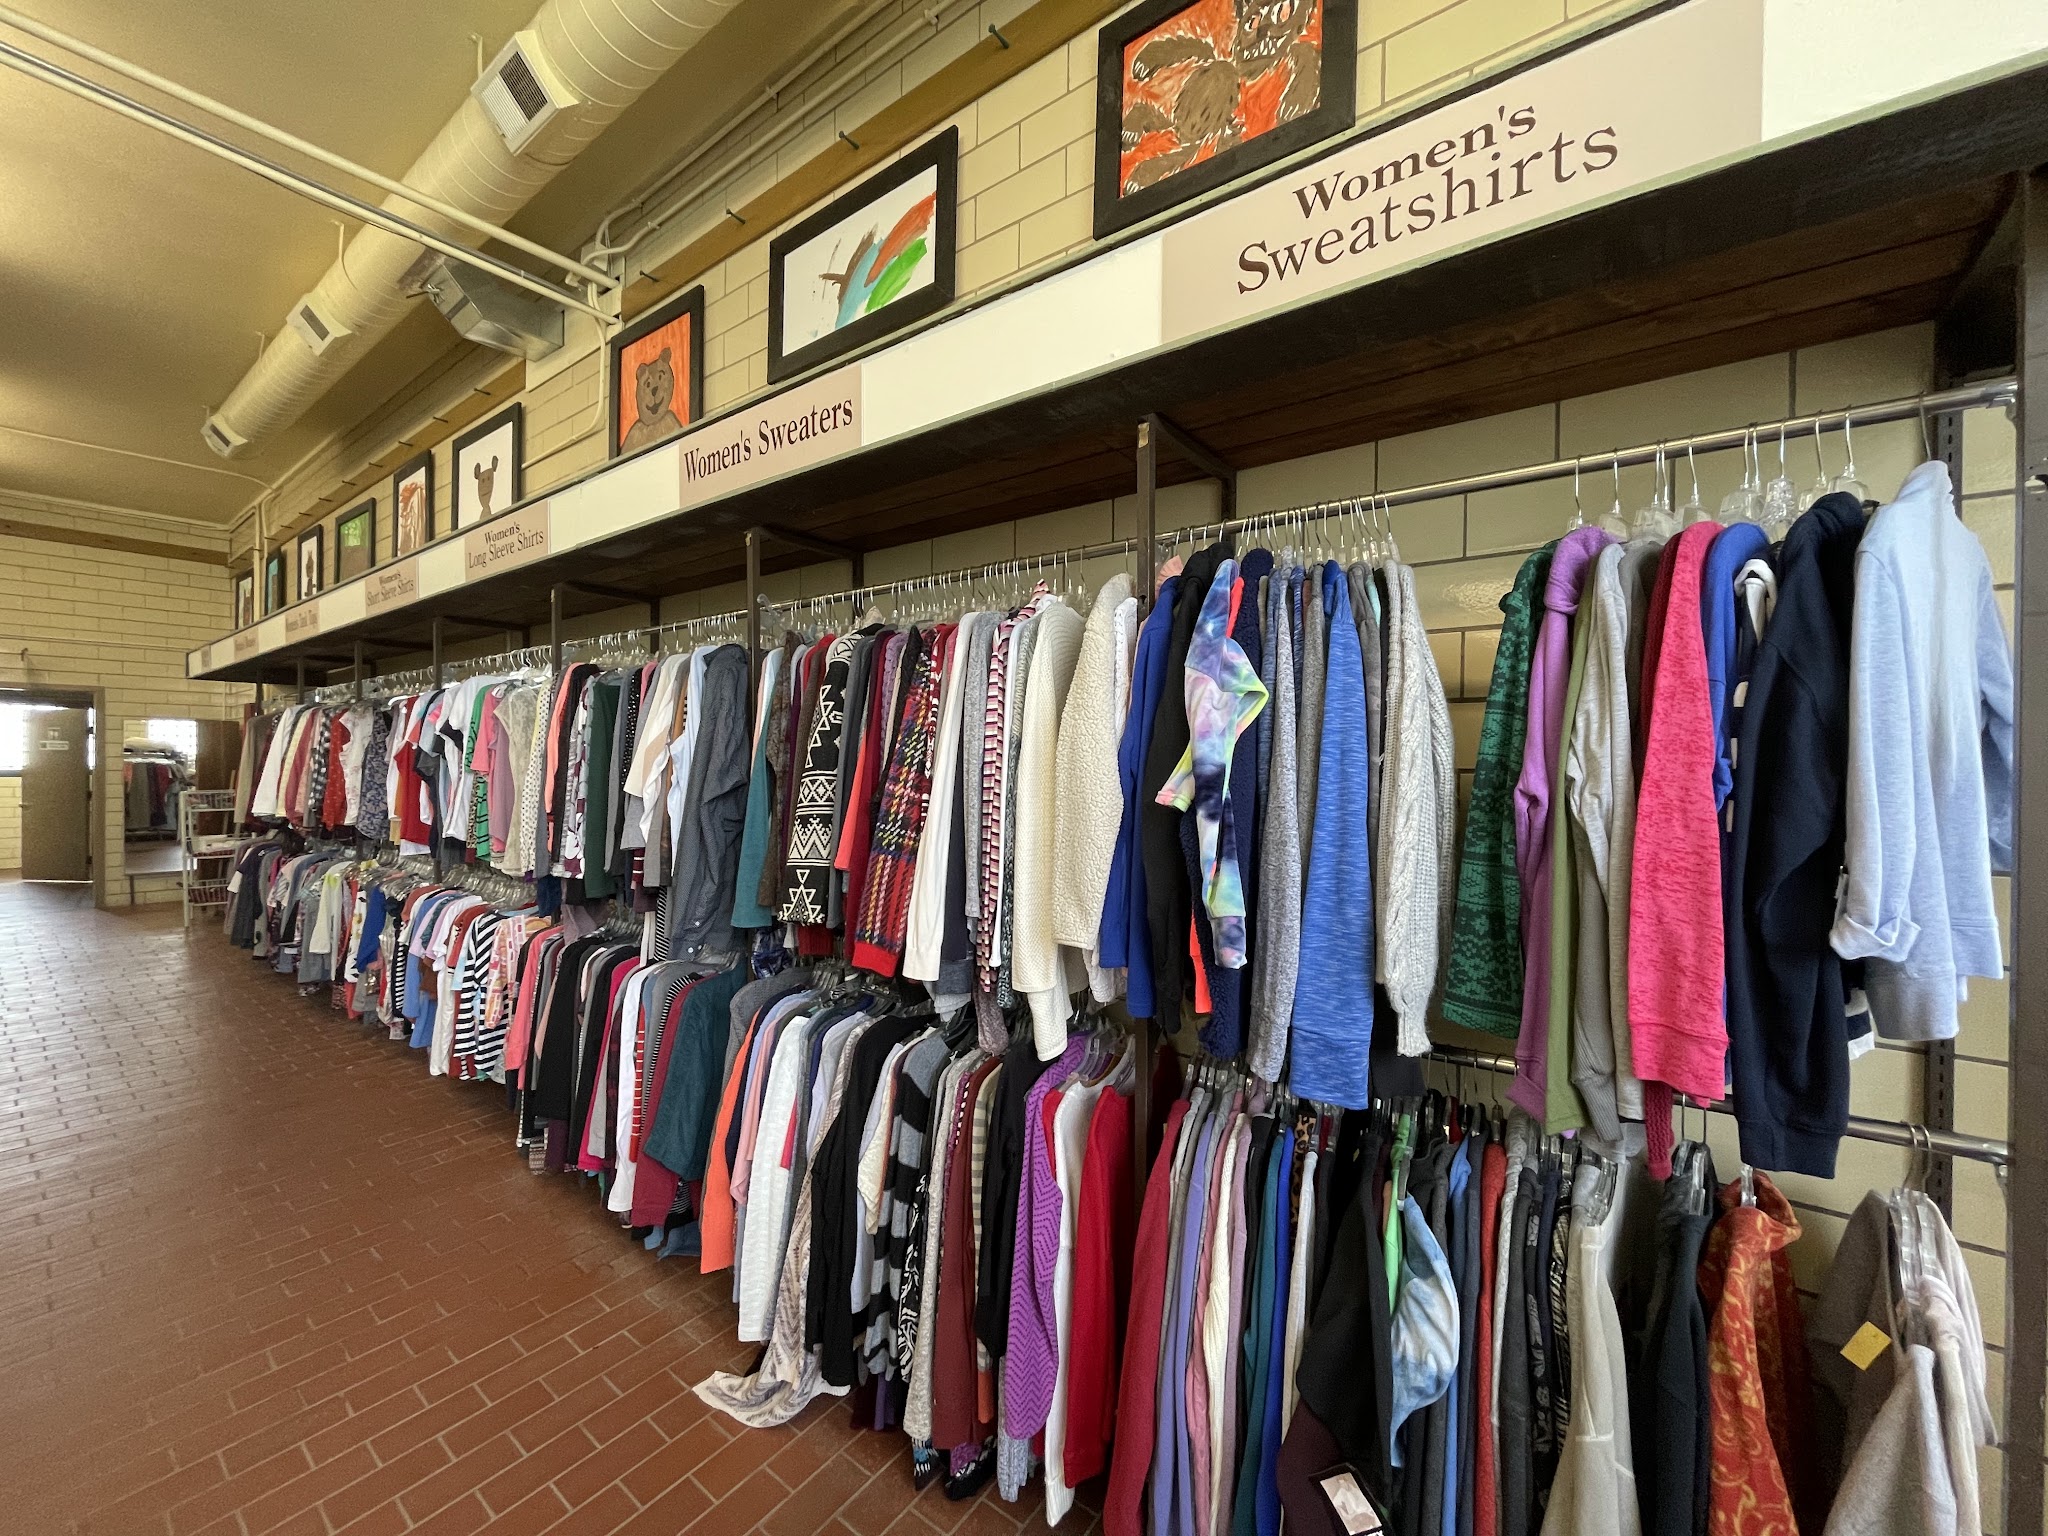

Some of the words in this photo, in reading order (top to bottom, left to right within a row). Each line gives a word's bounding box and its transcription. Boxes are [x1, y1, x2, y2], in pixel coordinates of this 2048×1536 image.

[1292, 105, 1537, 219] Women's
[1237, 126, 1618, 295] Sweatshirts
[684, 430, 751, 483] Women's
[758, 399, 853, 455] Sweaters
[468, 552, 486, 568] Long
[488, 541, 515, 561] Sleeve
[517, 529, 544, 551] Shirts
[484, 521, 520, 544] Women's
